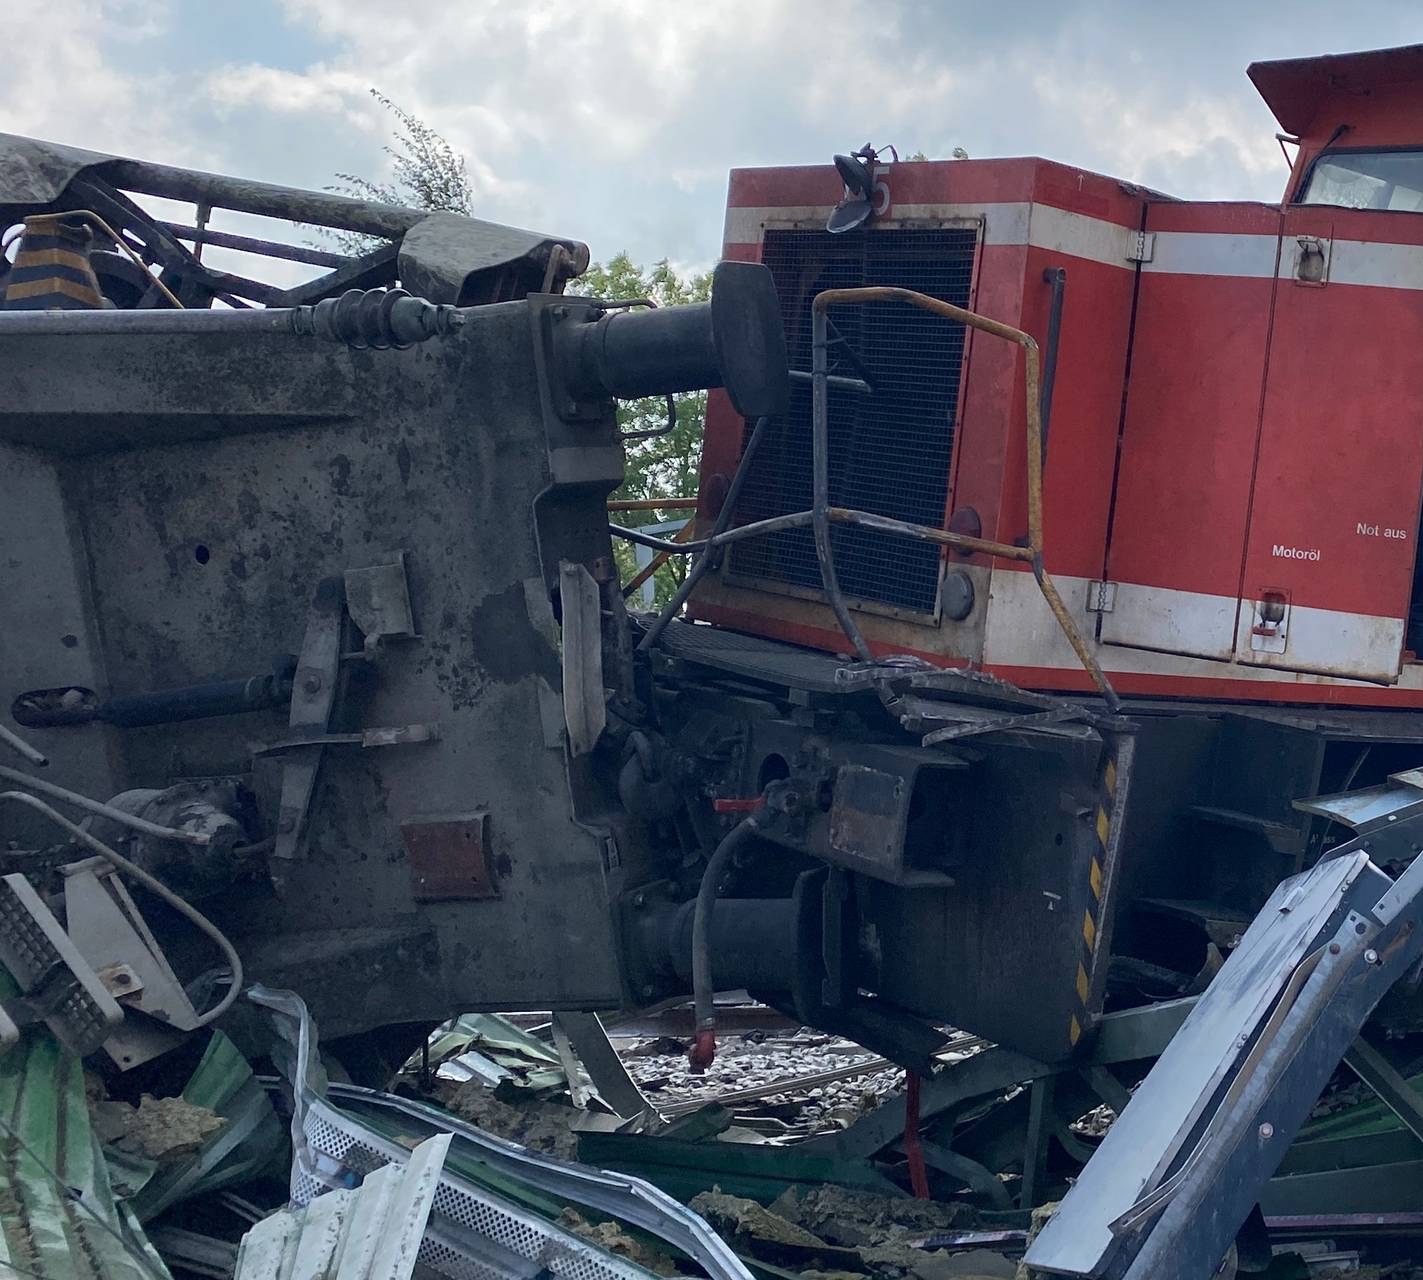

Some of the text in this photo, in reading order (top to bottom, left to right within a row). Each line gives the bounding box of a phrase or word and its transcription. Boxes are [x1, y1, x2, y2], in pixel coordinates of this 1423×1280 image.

[1356, 522, 1407, 539] Not aus
[1272, 545, 1320, 561] Motoröl
